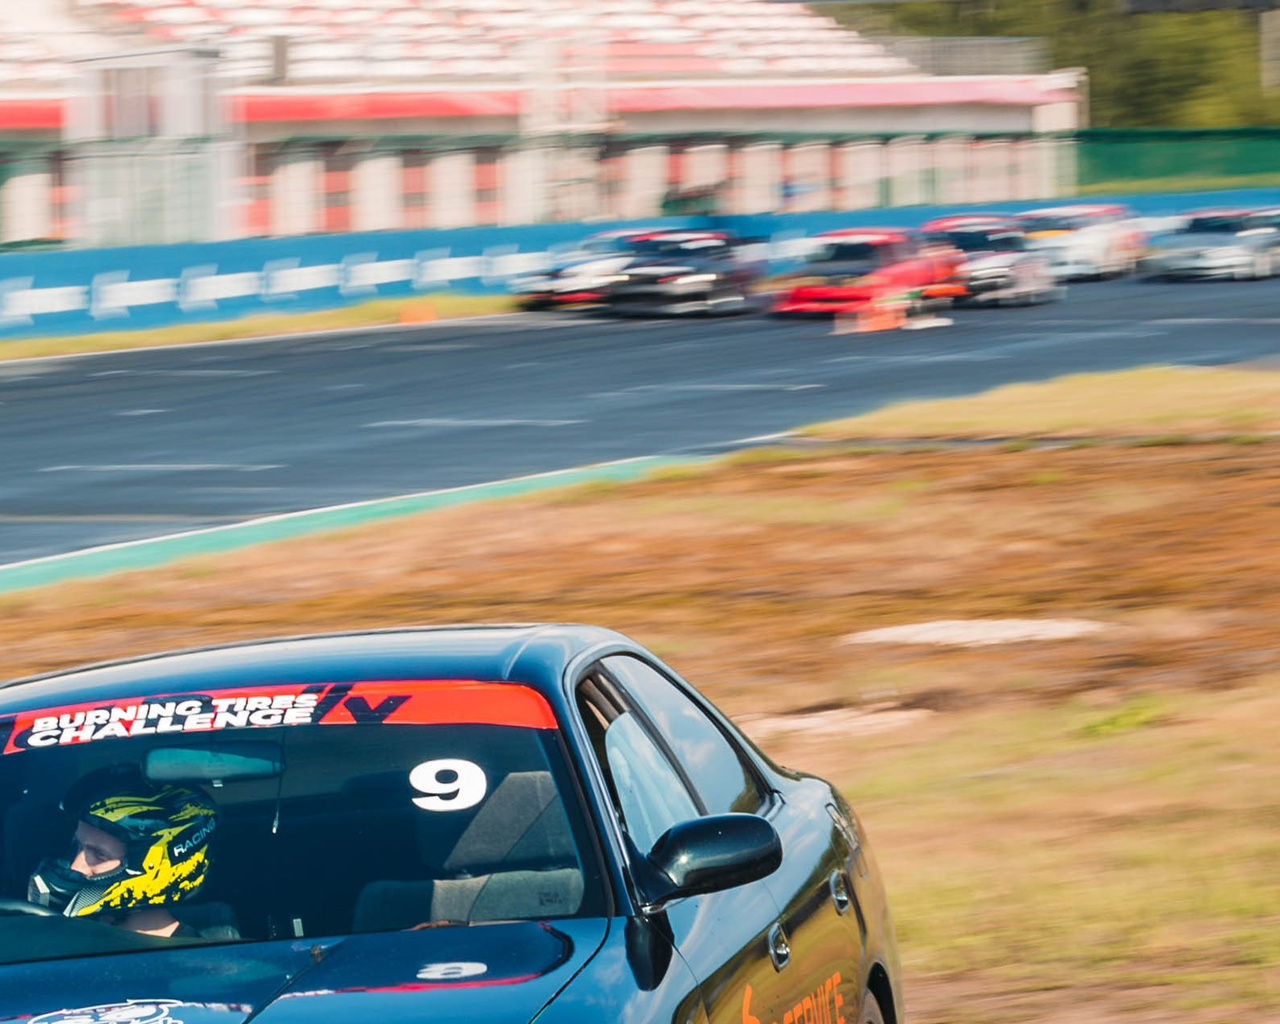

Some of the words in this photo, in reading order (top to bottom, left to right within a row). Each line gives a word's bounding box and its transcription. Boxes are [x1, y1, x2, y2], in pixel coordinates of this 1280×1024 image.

[27, 707, 315, 748] CHALLENGE
[32, 698, 203, 733] BURNING
[211, 693, 319, 712] TIRES
[408, 758, 488, 812] 9
[173, 817, 216, 857] RACING
